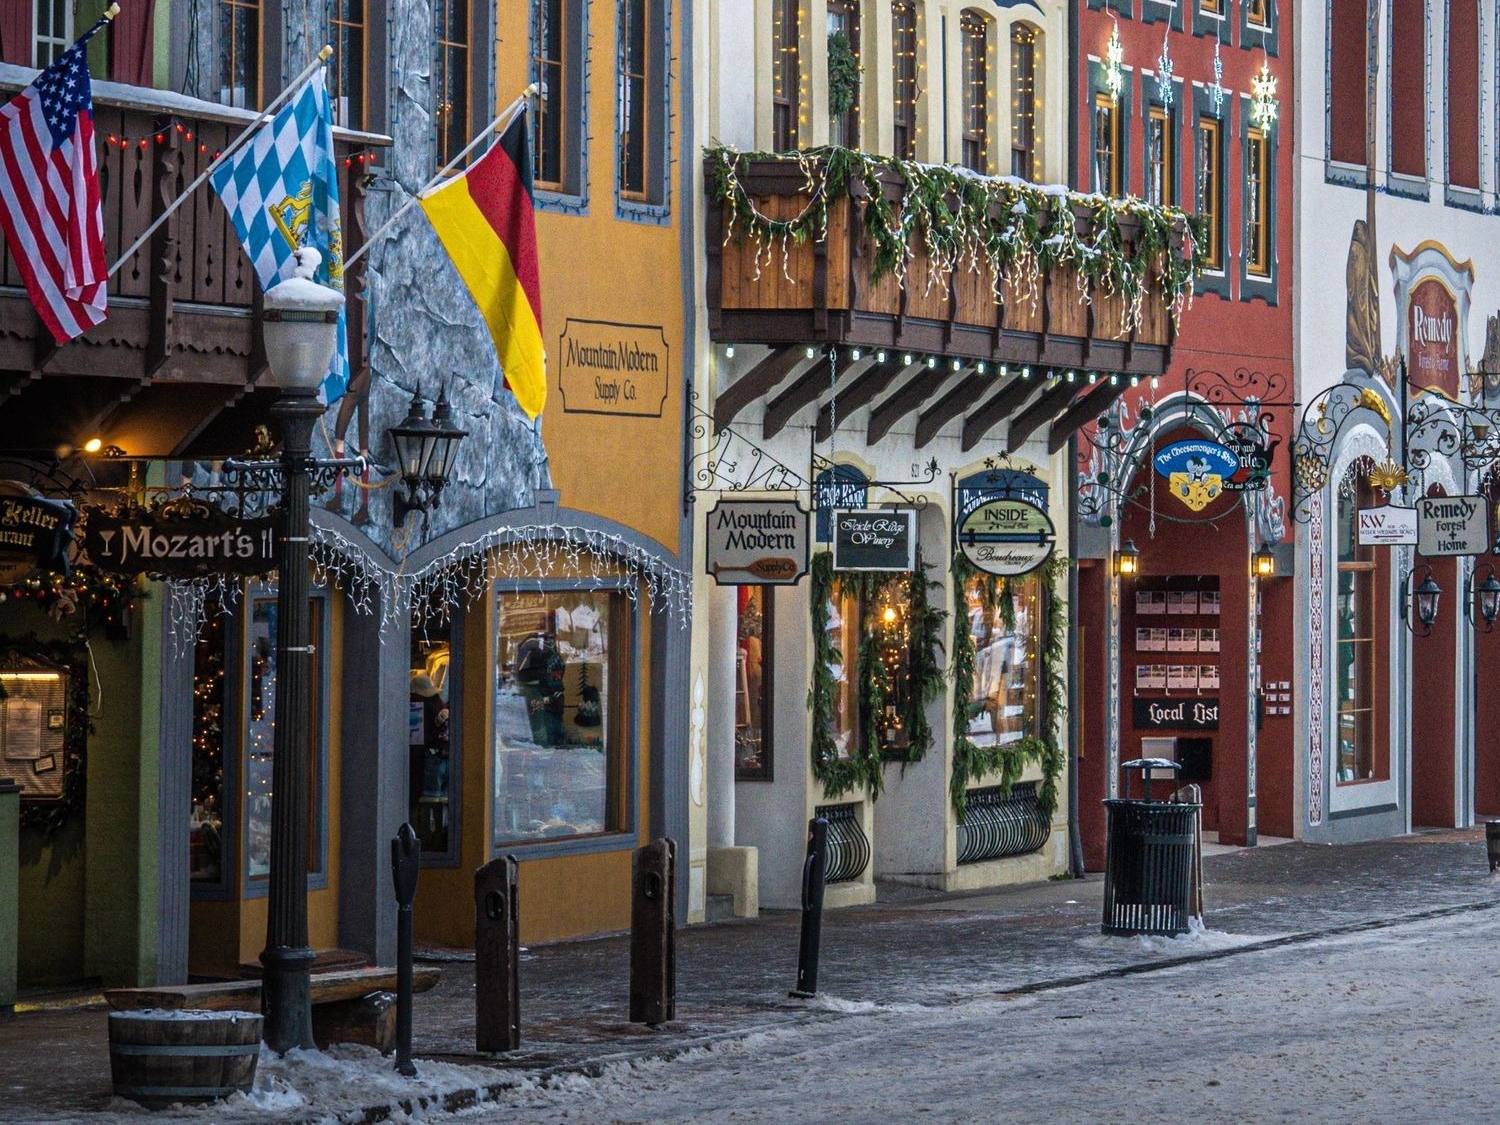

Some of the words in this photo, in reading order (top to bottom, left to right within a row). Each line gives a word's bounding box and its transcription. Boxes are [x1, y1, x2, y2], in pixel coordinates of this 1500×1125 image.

[1413, 305, 1452, 354] Remedy
[566, 337, 617, 370] Mountain
[617, 340, 658, 372] Modern
[594, 375, 620, 405] Supply
[1157, 452, 1172, 465] The
[1170, 444, 1221, 457] Cheesemonger's
[1220, 450, 1237, 467] Shop
[1243, 442, 1256, 452] and
[2, 499, 59, 530] Keller
[716, 508, 796, 530] Mountain
[984, 508, 1029, 521] INSIDE
[1423, 498, 1476, 520] Remedy
[840, 518, 871, 531] Icicle
[872, 518, 905, 535] Ridge
[1360, 514, 1386, 529] KW
[1436, 520, 1466, 531] Forest
[120, 525, 254, 565] Mozart's
[725, 530, 796, 550] Modern
[851, 531, 894, 549] Winery
[1438, 540, 1467, 552] Home
[976, 546, 1035, 568] Boudreaux
[1149, 702, 1184, 724] Local
